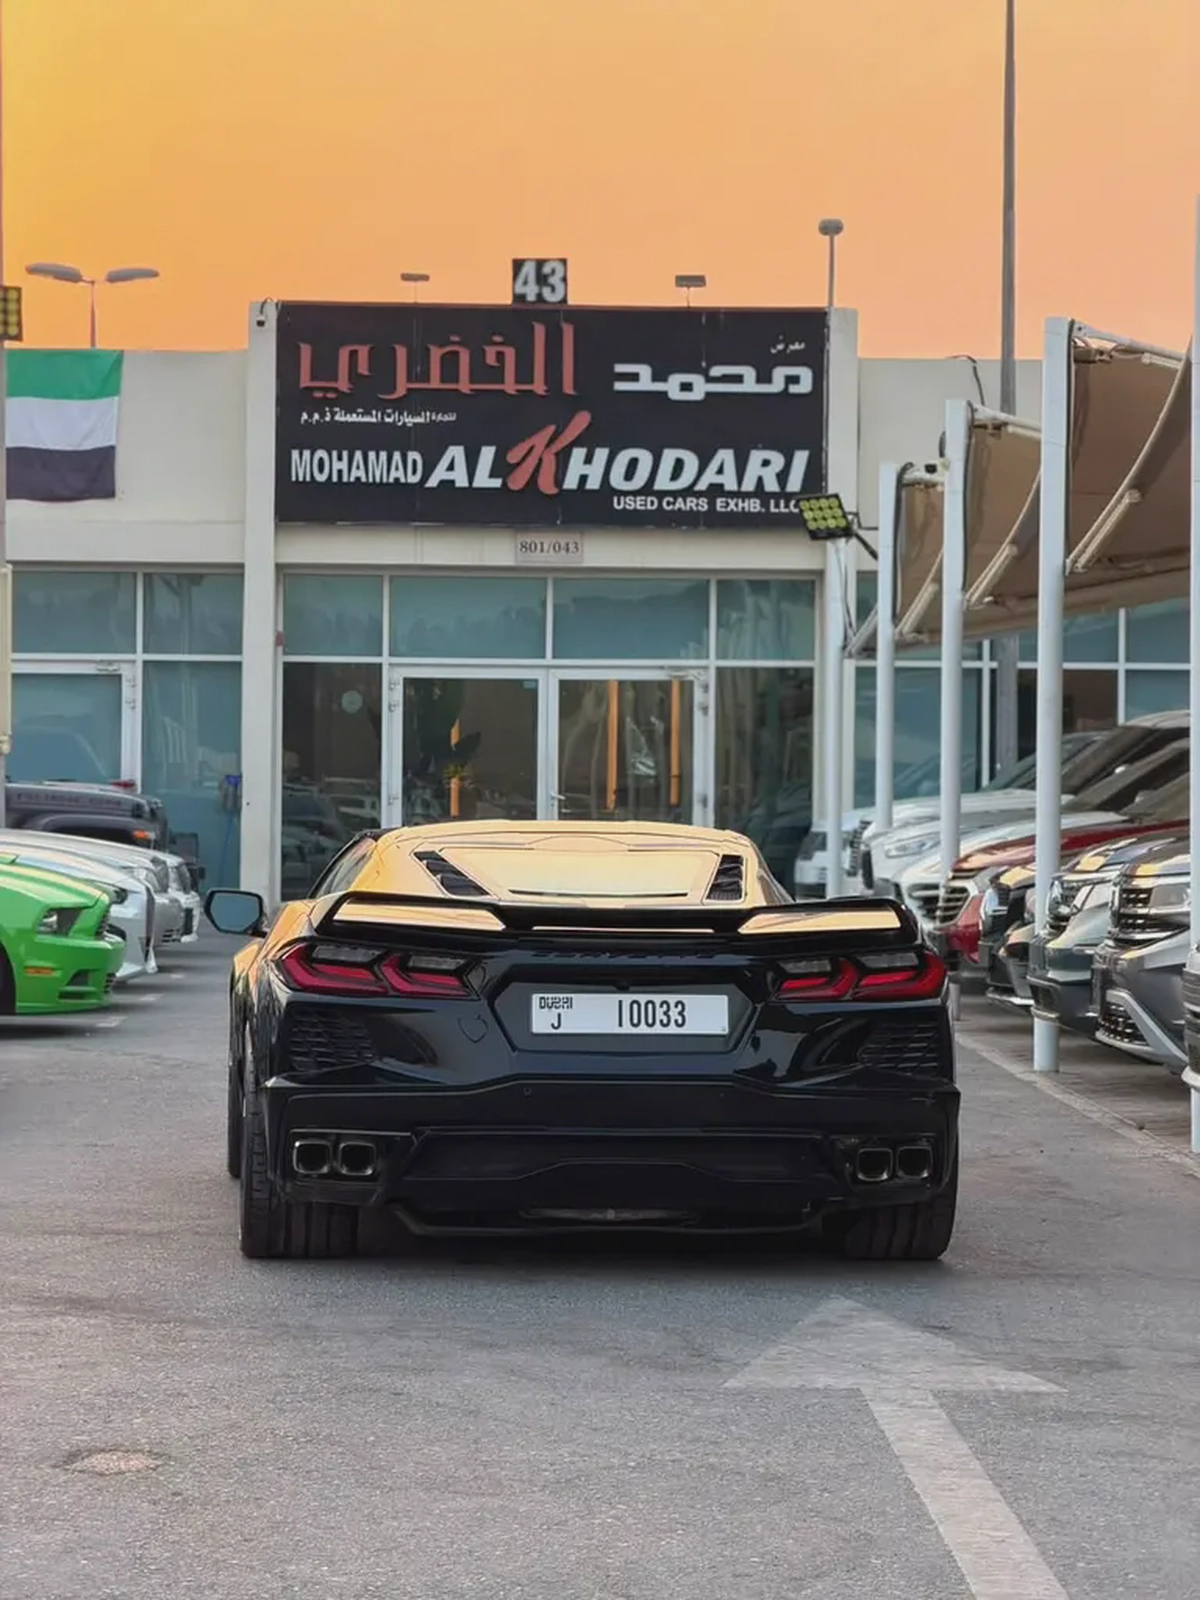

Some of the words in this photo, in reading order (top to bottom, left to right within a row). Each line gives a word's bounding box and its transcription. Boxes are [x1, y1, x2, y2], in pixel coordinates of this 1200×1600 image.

[515, 260, 566, 302] 43
[297, 321, 577, 399] الخضري
[613, 363, 813, 401] محمد
[334, 407, 381, 424] المستعملة
[384, 409, 431, 427] السيارات
[290, 448, 424, 485] MOHAMAD
[613, 496, 659, 511] USED
[662, 497, 709, 512] CARS
[715, 498, 766, 513] EXHB.
[519, 540, 580, 555] 801/043
[538, 996, 573, 1010] DUBAI
[550, 1012, 562, 1030] J
[617, 999, 687, 1029] 10033
